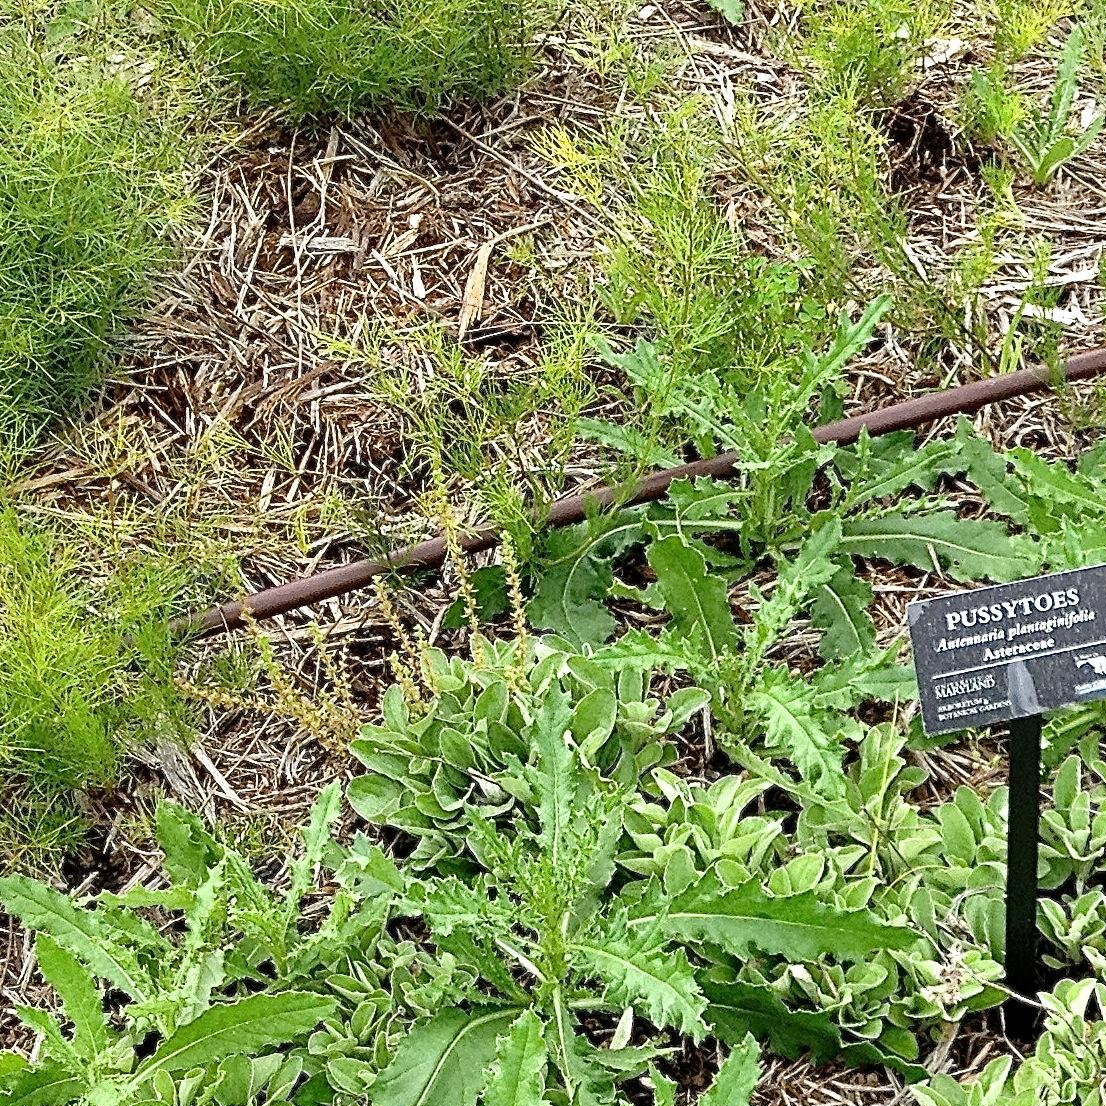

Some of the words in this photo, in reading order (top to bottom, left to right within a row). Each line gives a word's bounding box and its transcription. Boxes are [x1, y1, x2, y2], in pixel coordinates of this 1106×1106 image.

[945, 588, 1081, 631] PUSSYTOES
[936, 628, 1005, 653] Antennaria
[1008, 610, 1096, 641] plantaginifolia
[982, 638, 1055, 662] Asteraceae
[935, 679, 996, 700] MARYLAND
